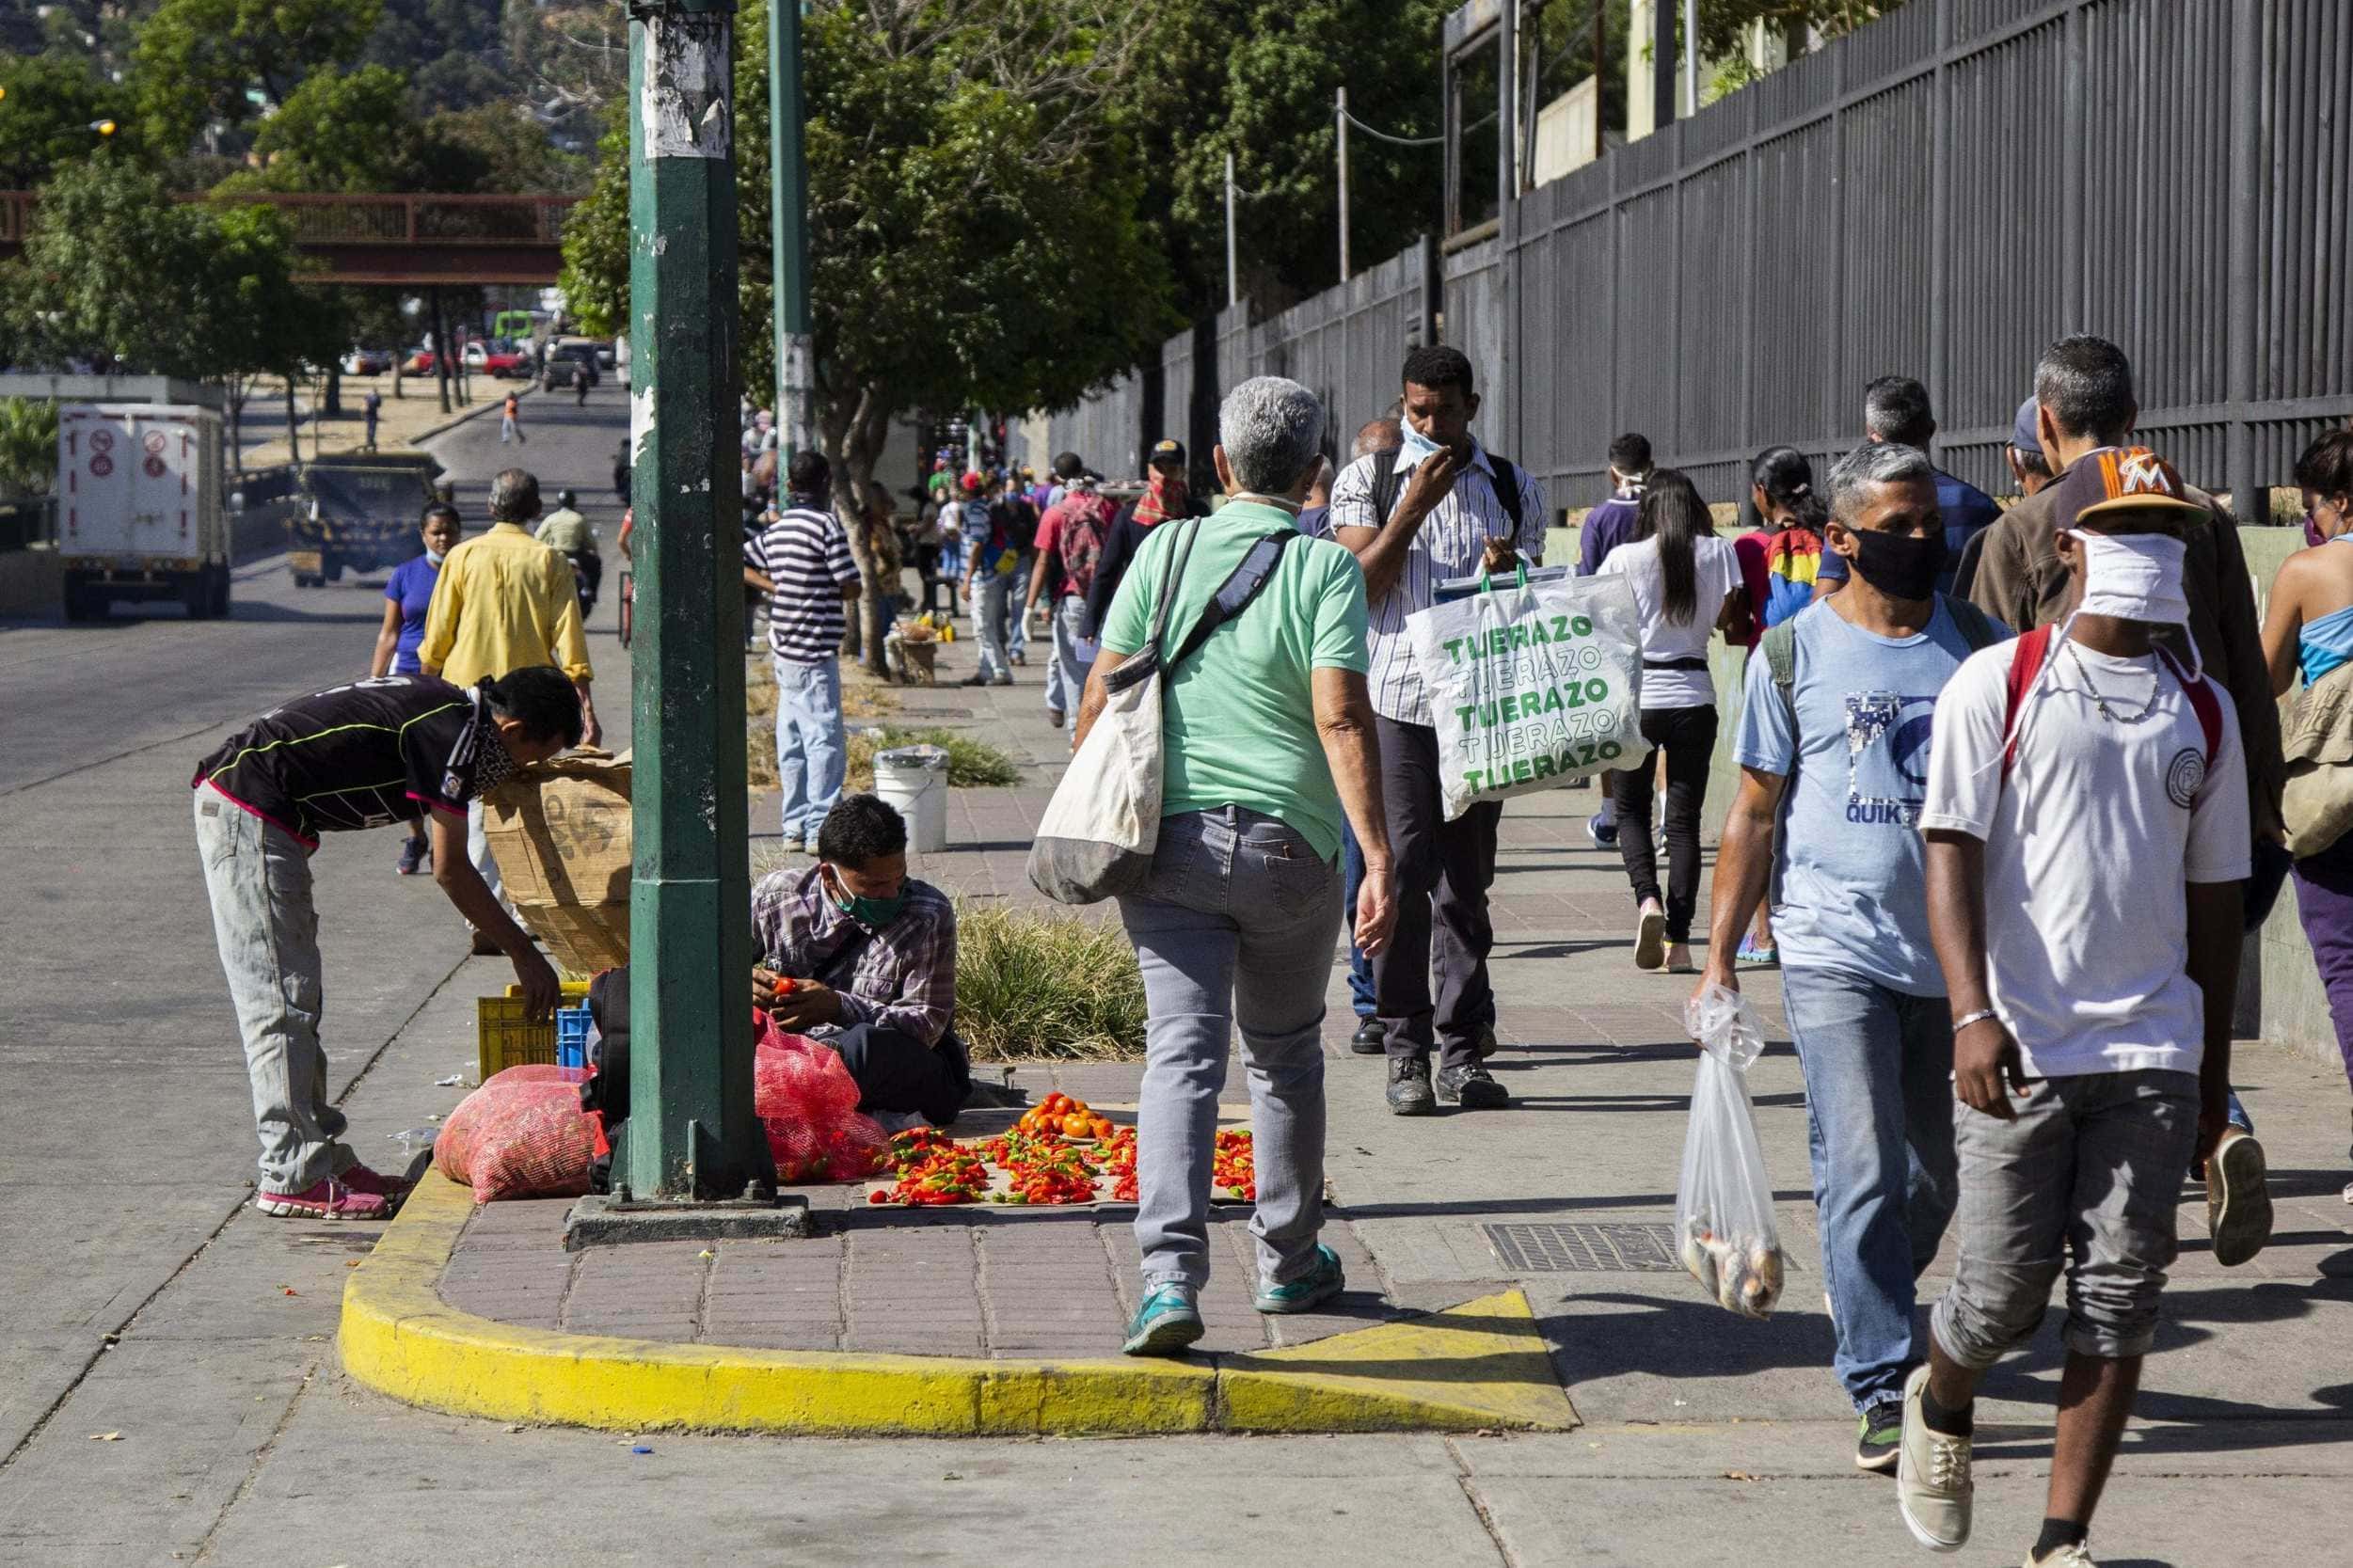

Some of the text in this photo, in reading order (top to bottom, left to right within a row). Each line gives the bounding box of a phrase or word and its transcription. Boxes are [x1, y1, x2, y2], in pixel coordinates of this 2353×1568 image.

[2120, 452, 2171, 492] M
[1441, 615, 1593, 664] TIJERAZO
[1450, 645, 1601, 698] TIJERAZO
[1455, 677, 1608, 731] TIJERAZO
[1459, 709, 1615, 764] TIJERAZO
[1464, 740, 1622, 795] TIJERAZO
[1847, 803, 1917, 828] QUIK
